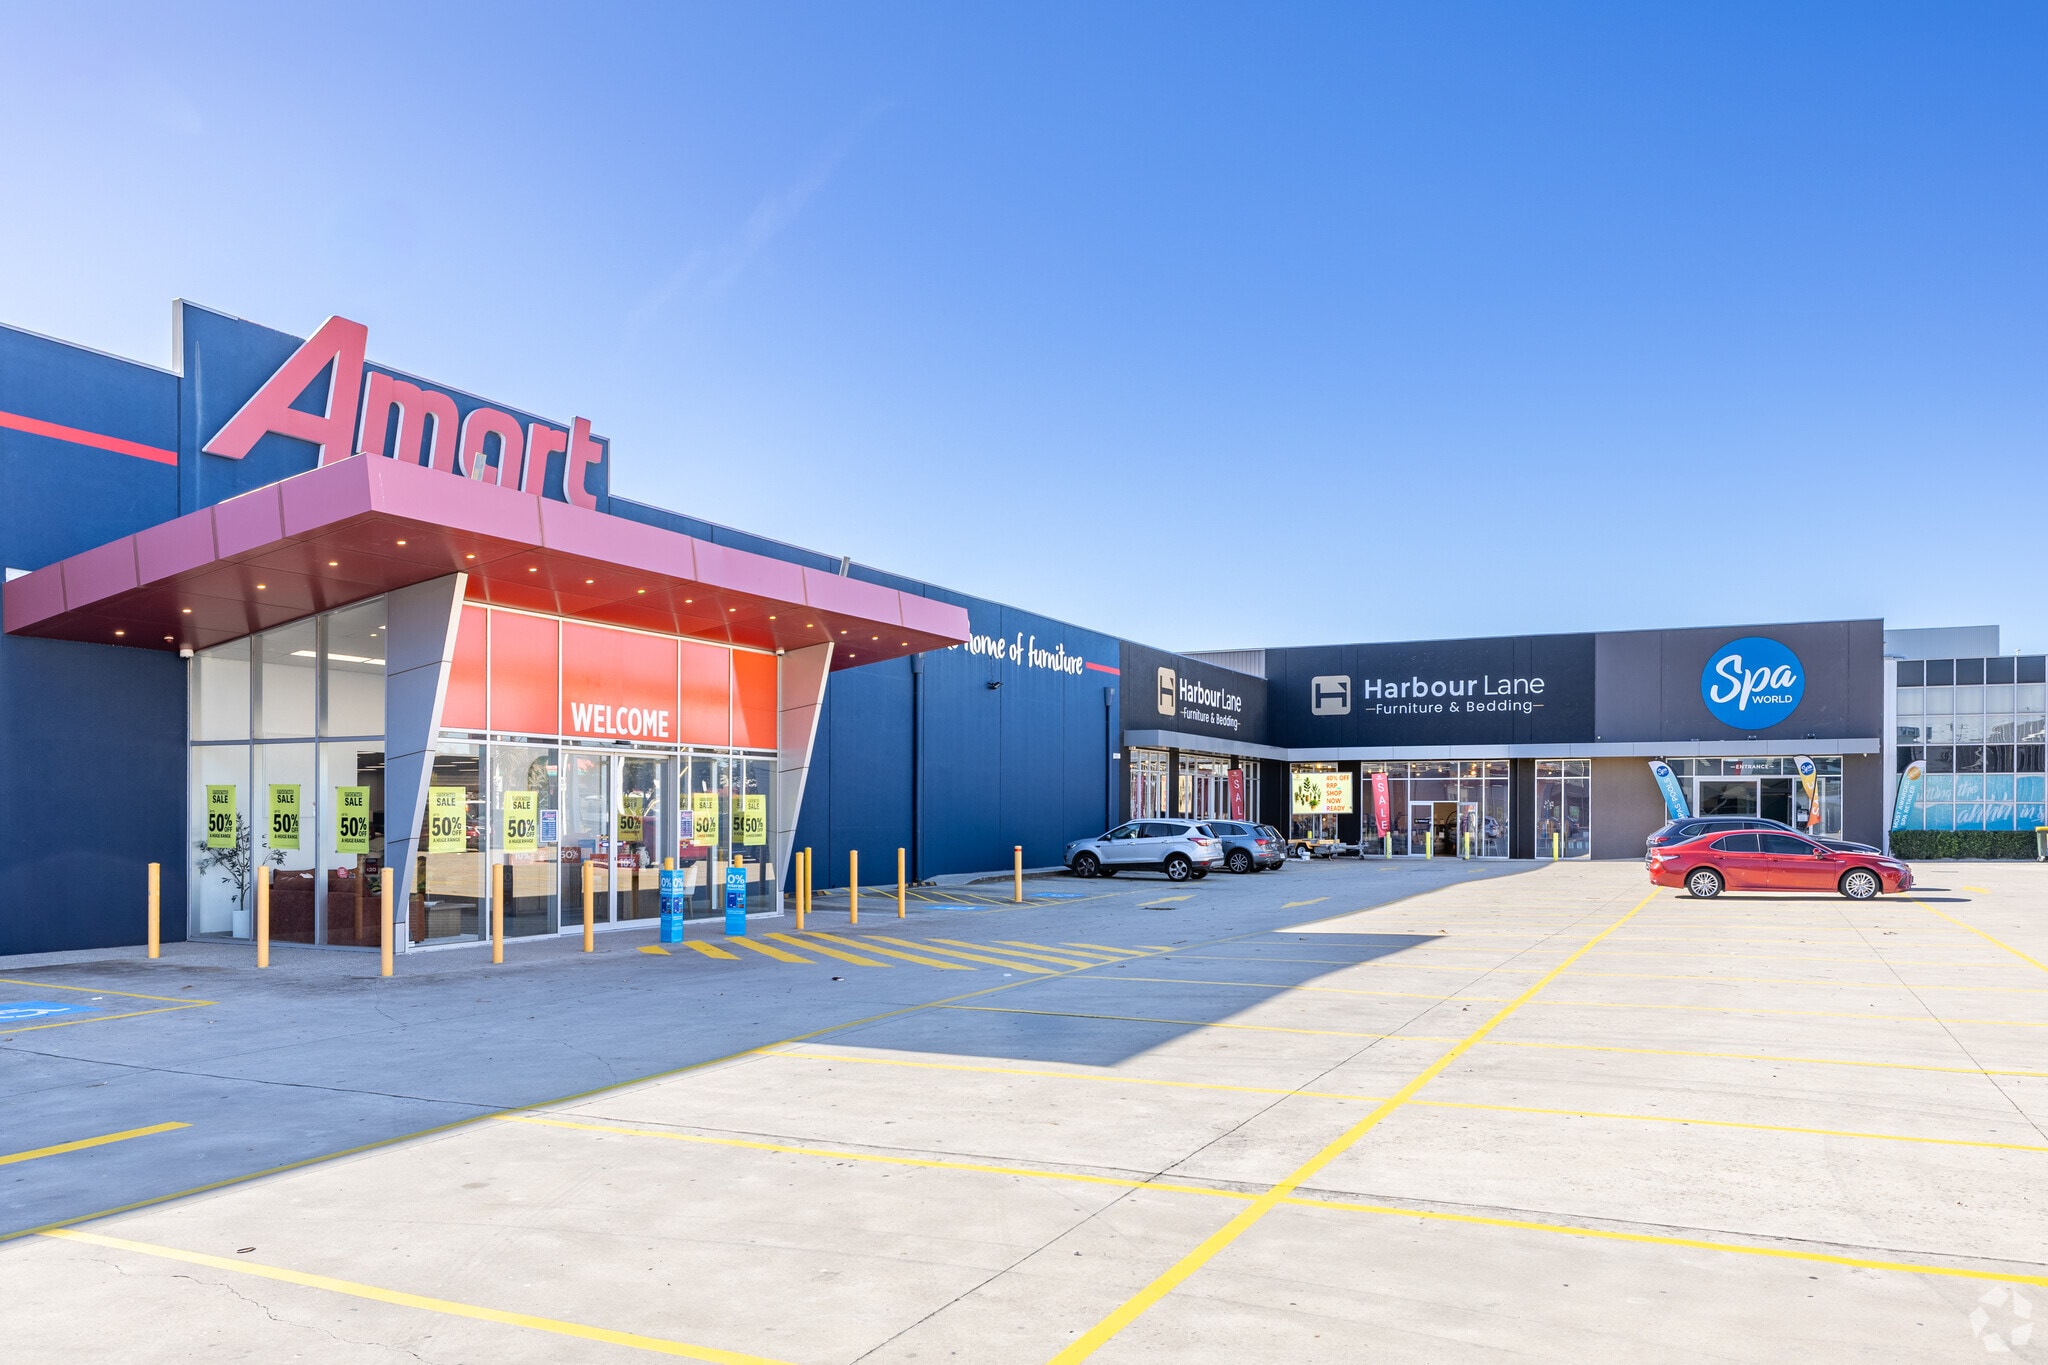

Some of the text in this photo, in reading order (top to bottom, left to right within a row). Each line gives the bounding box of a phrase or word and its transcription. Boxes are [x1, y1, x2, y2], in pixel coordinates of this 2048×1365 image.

[202, 315, 603, 512] Amart
[1009, 631, 1024, 666] of
[1028, 635, 1083, 675] furniture
[1364, 675, 1545, 699] Harbour Lane
[1710, 654, 1797, 711] Spa
[1179, 677, 1242, 713] Harbour Lane
[1752, 695, 1793, 704] WORLD
[1376, 699, 1533, 714] Furniture & Bedding
[571, 702, 669, 738] WELCOME
[1183, 706, 1238, 731] Furniture & Bedding
[212, 795, 228, 803] SALE
[277, 795, 294, 803] SALE
[1663, 777, 1678, 802] POOLS
[1898, 780, 1910, 810] AWARDED
[1903, 785, 1916, 813] RETAILER
[344, 797, 362, 806] SALE
[436, 797, 456, 806] SALE
[512, 801, 531, 809] SALE
[699, 801, 713, 809] SALE
[1233, 780, 1243, 820] SAL
[1377, 783, 1389, 830] SALE
[209, 813, 233, 832] 50%
[273, 813, 299, 832] 50%
[340, 817, 368, 836] 50%
[431, 817, 462, 836] 50%
[508, 819, 535, 838] 50%
[620, 816, 641, 830] 50%
[696, 817, 716, 832] 50%
[745, 817, 763, 832] 50%
[661, 877, 671, 888] 0%
[672, 877, 684, 888] 0%
[727, 874, 745, 884] 0%
